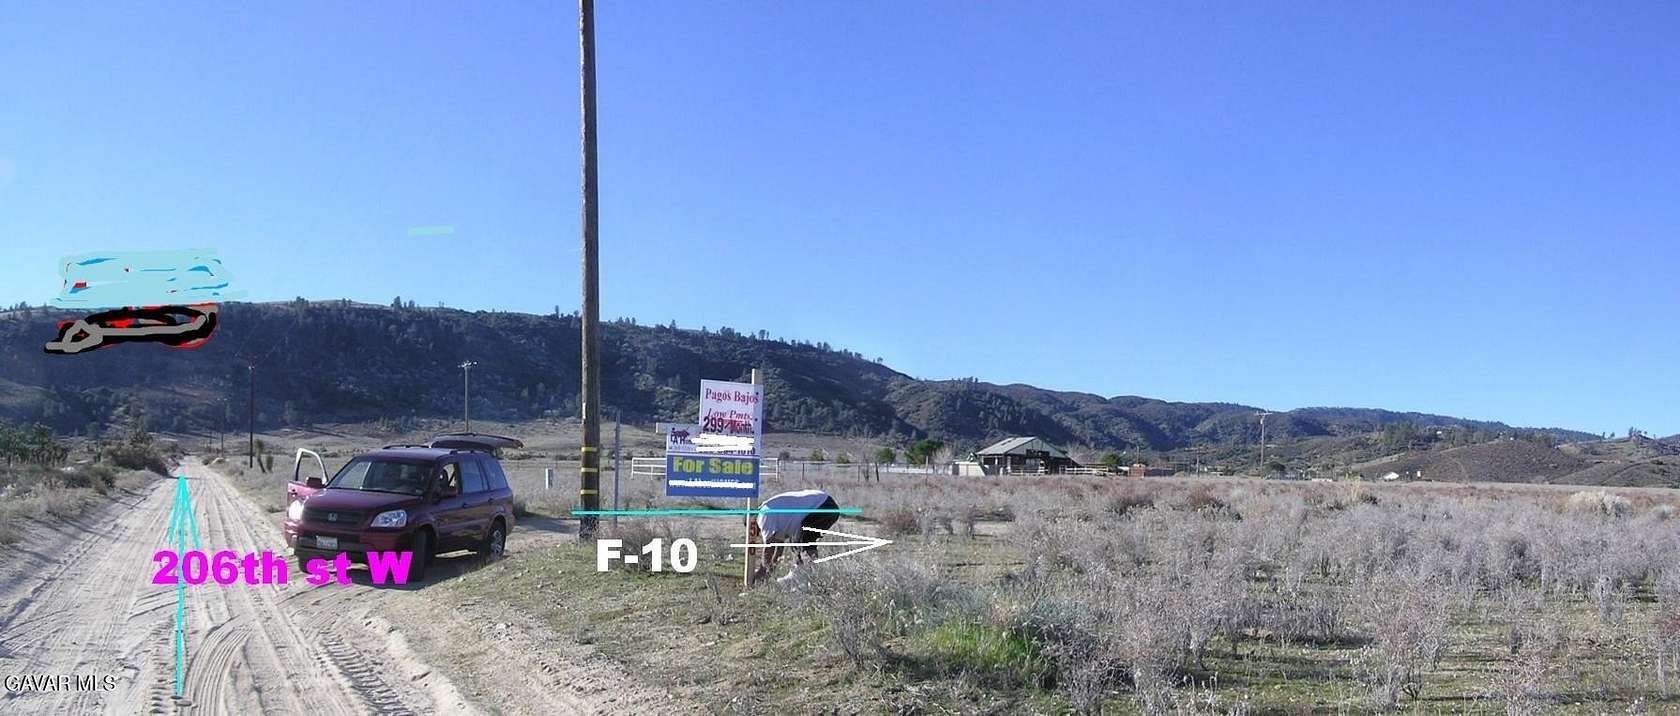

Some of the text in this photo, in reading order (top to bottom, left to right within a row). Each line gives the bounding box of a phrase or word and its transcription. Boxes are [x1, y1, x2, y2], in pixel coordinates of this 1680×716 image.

[705, 388, 759, 405] Pagos Bajos
[672, 456, 753, 475] For Sale
